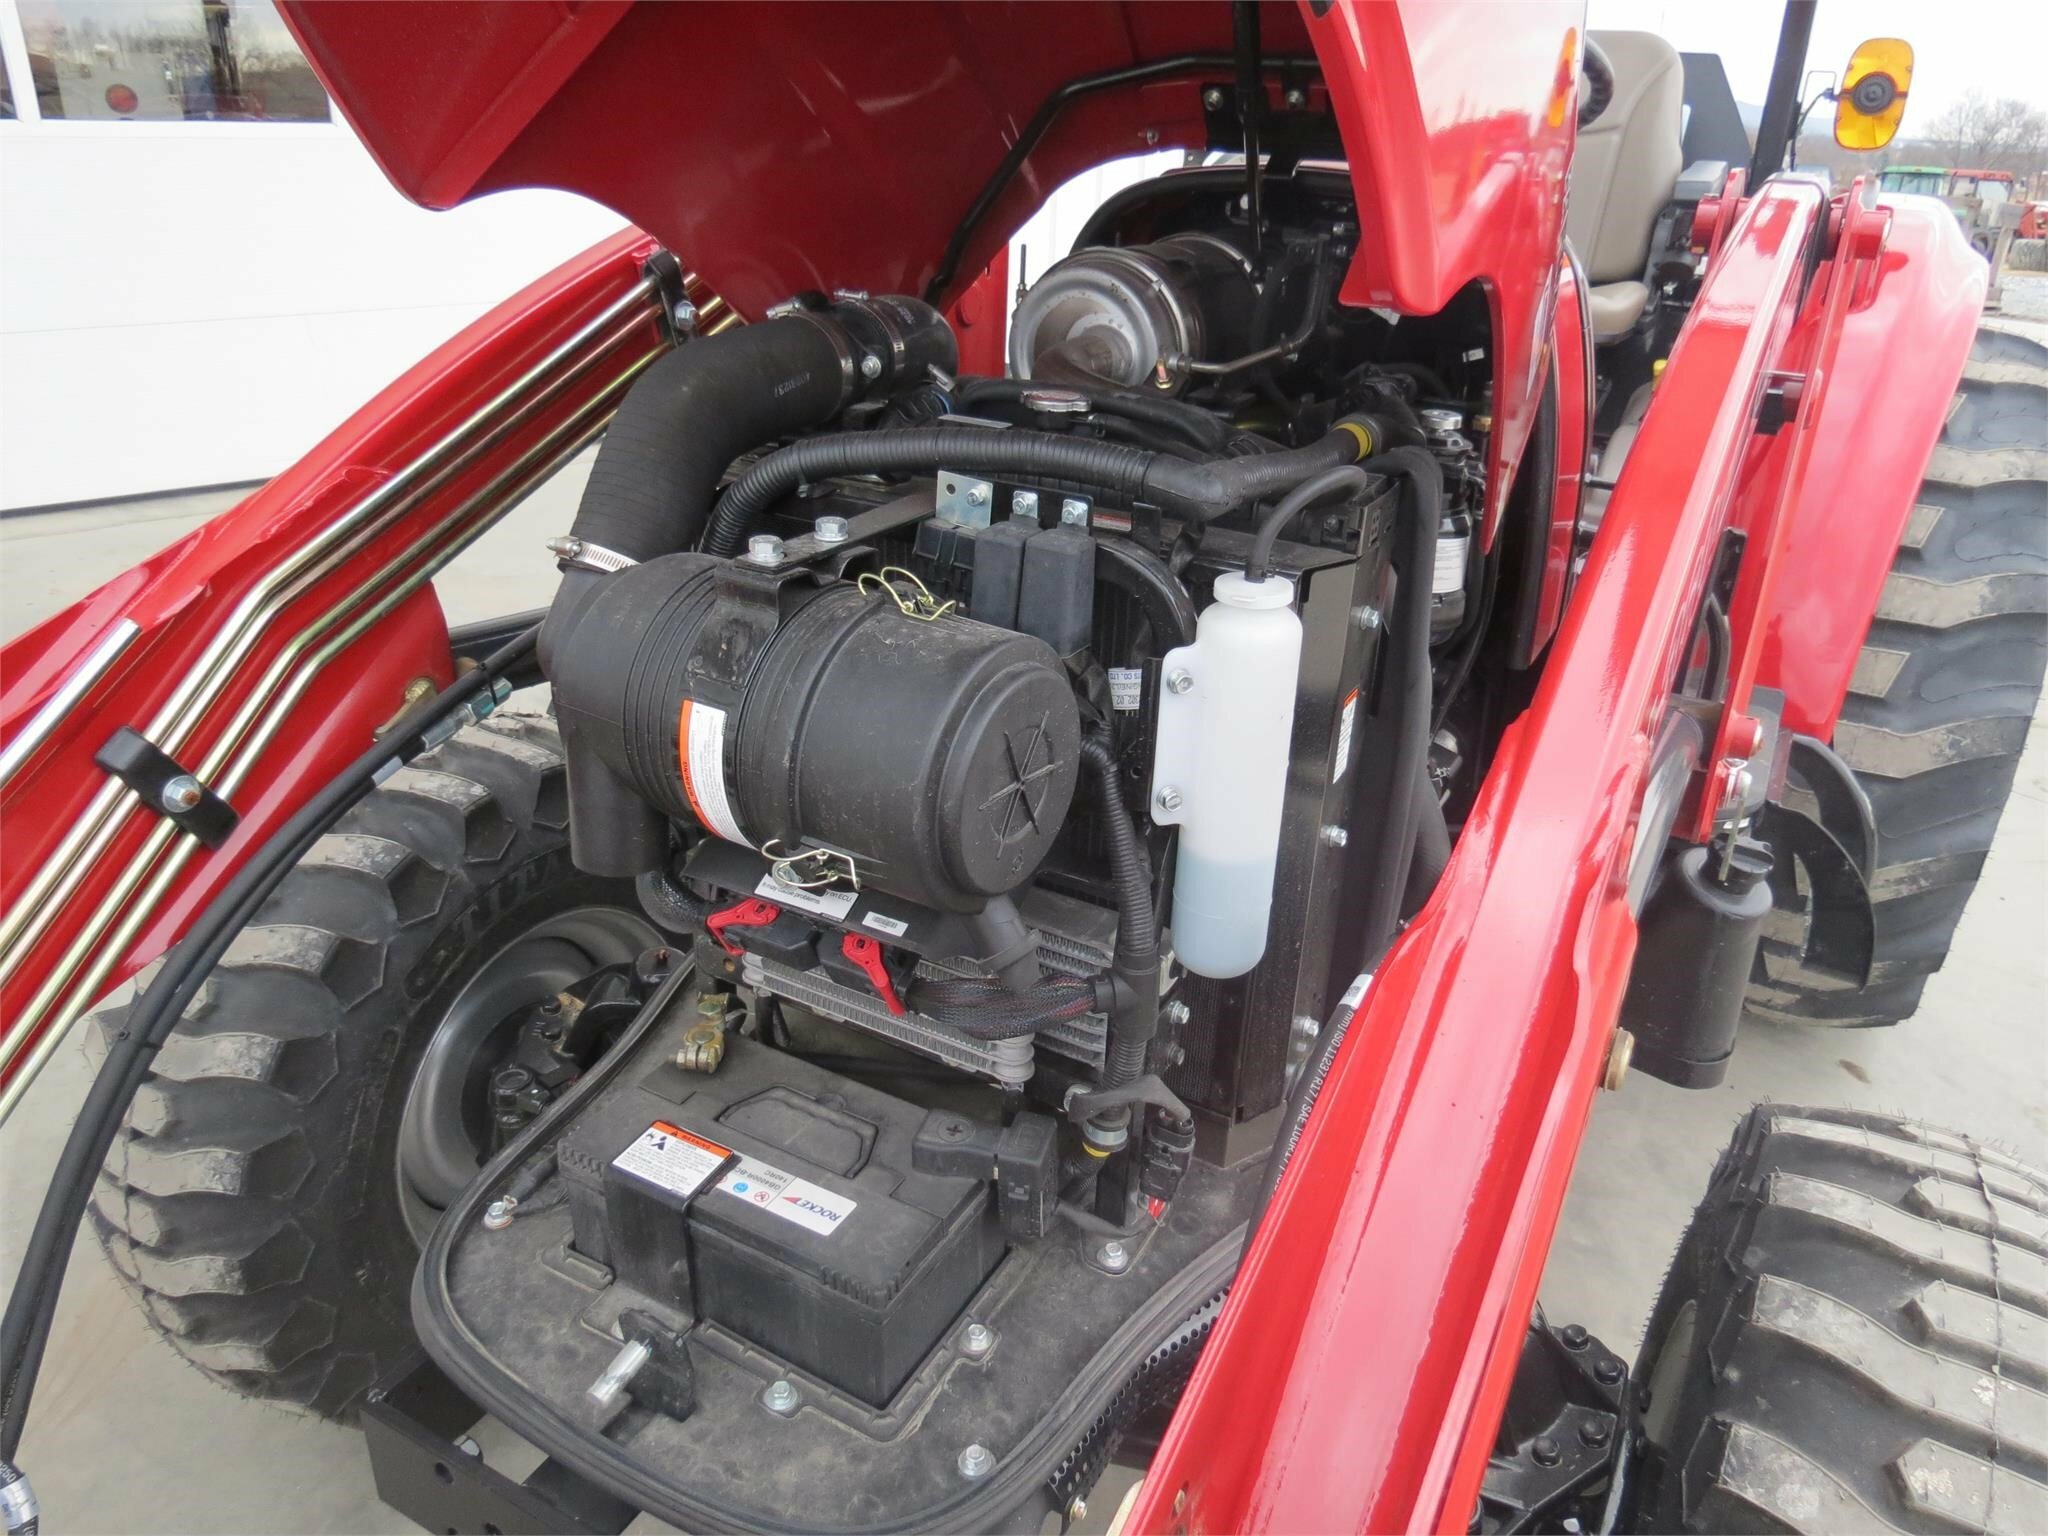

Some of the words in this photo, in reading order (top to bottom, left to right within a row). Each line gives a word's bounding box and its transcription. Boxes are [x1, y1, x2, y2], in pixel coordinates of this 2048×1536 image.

[1330, 1031, 1345, 1048] ISO
[1318, 1045, 1337, 1077] 11237
[1309, 1076, 1324, 1098] R17
[1297, 1103, 1312, 1122] SAE
